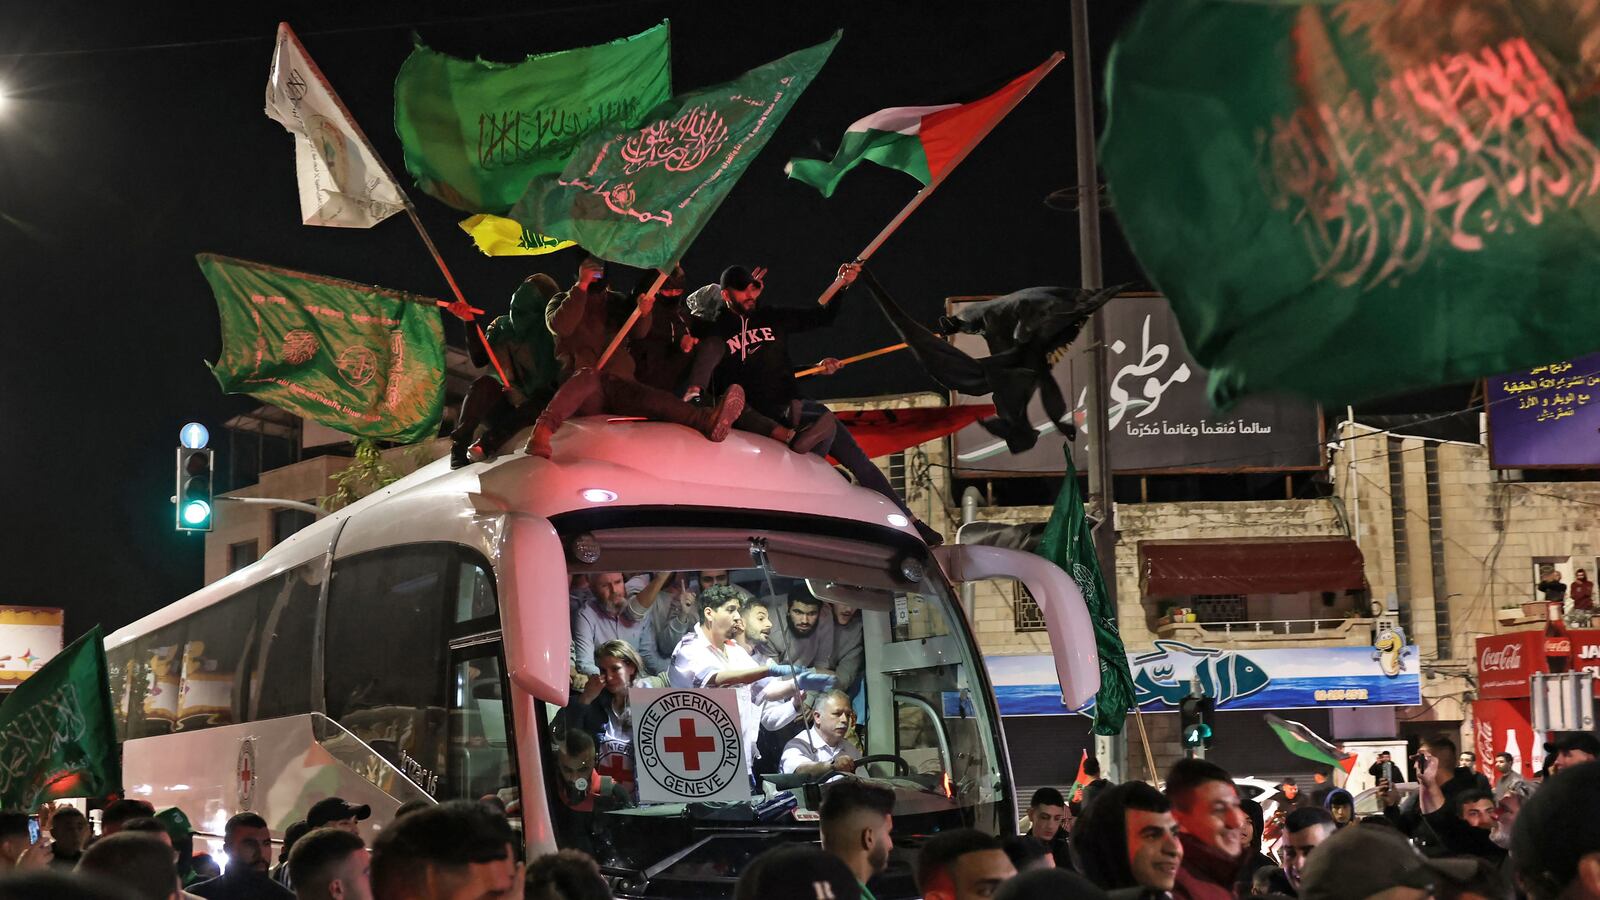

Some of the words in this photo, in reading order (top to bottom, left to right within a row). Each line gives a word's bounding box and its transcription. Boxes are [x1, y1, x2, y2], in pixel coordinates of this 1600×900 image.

[726, 327, 776, 354] NIKE
[1577, 393, 1591, 405] مع
[1578, 645, 1600, 659] JA
[641, 709, 661, 768] COMITE
[659, 694, 739, 768] INTERNATIONAL
[663, 773, 725, 795] GENEVE
